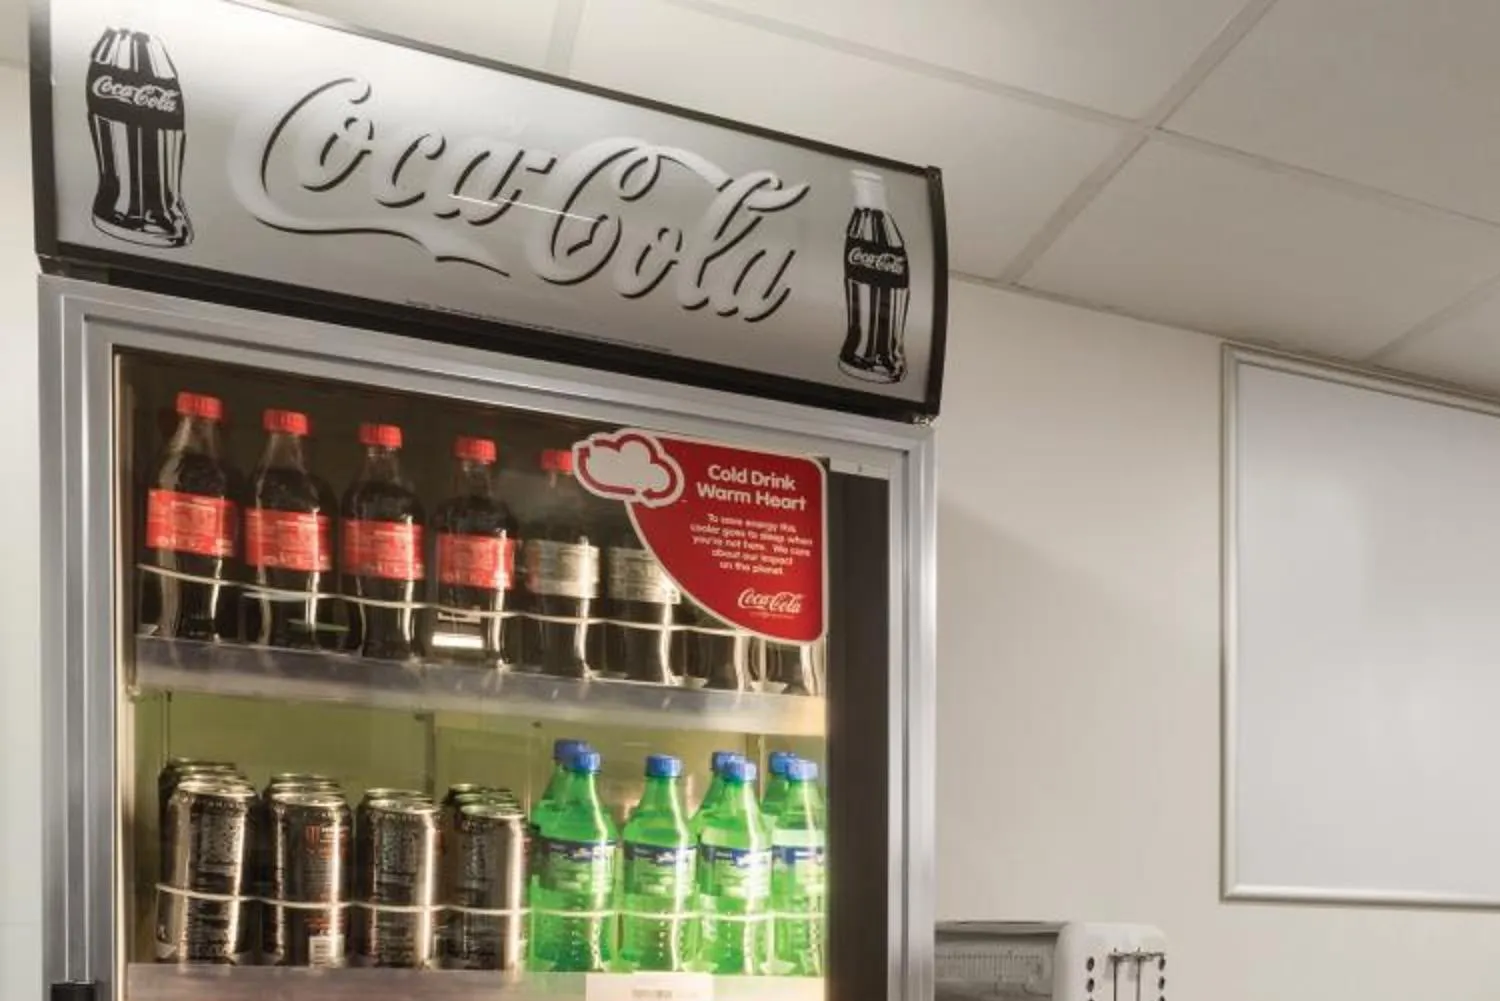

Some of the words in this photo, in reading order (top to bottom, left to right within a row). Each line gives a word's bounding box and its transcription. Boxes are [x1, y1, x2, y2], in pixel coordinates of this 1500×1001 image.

[707, 463, 748, 484] Cold
[750, 469, 797, 491] Drink
[696, 480, 751, 503] Warm
[755, 490, 806, 511] Heart
